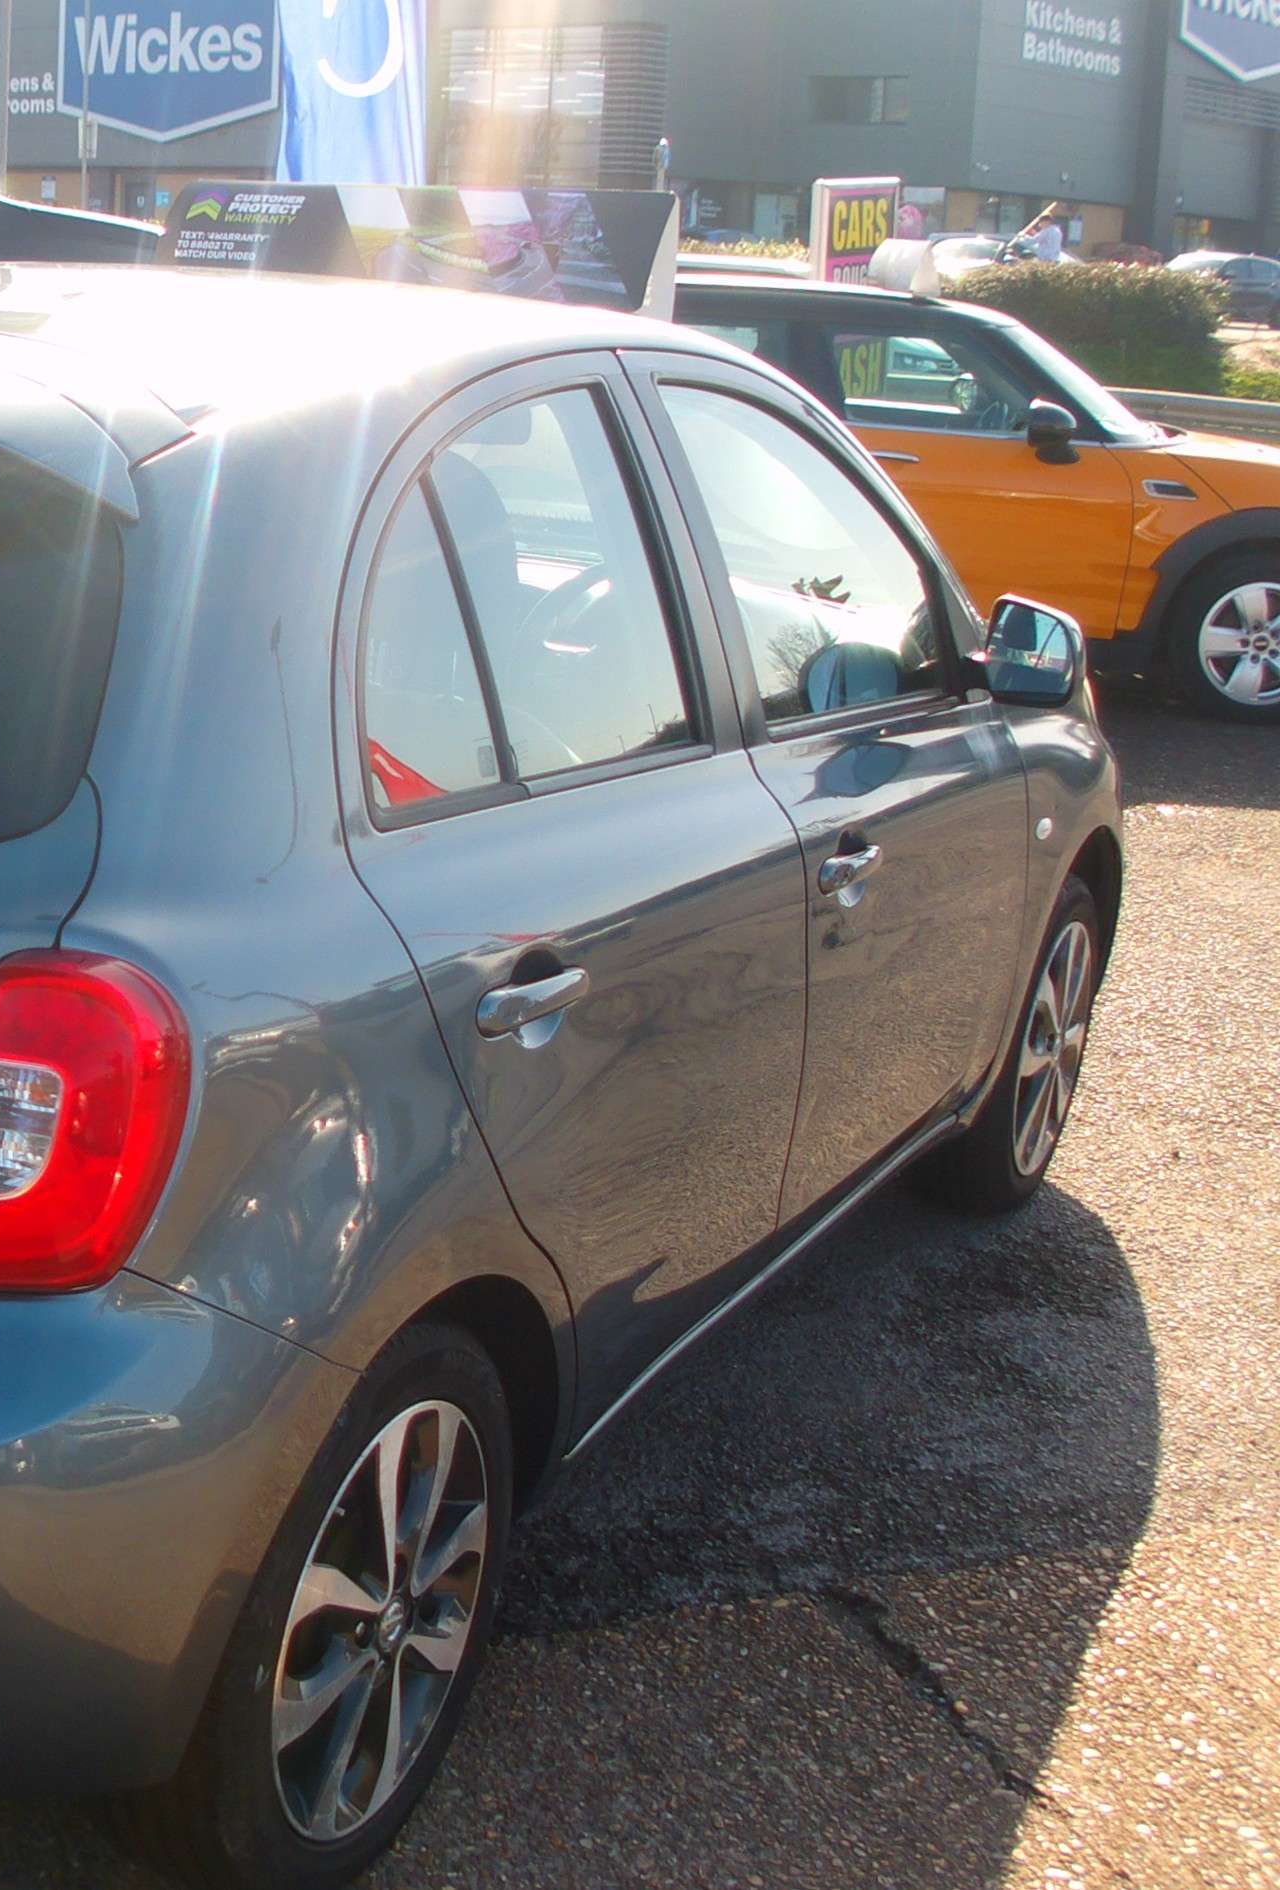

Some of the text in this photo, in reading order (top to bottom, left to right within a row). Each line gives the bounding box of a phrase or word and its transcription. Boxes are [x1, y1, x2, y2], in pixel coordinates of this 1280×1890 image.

[1024, 0, 1106, 42] Kitchens
[74, 11, 263, 75] Wickes
[1022, 31, 1121, 76] Bathrooms
[41, 71, 55, 92] &
[227, 201, 302, 215] PROTECT
[234, 193, 306, 204] CUSTOMER
[224, 213, 297, 225] WARRANTY
[832, 198, 889, 252] CARS
[175, 249, 206, 259] WATCH
[228, 251, 257, 262] VIDEO
[177, 240, 189, 248] TO
[222, 241, 235, 250] TO
[840, 342, 882, 398] ASH
